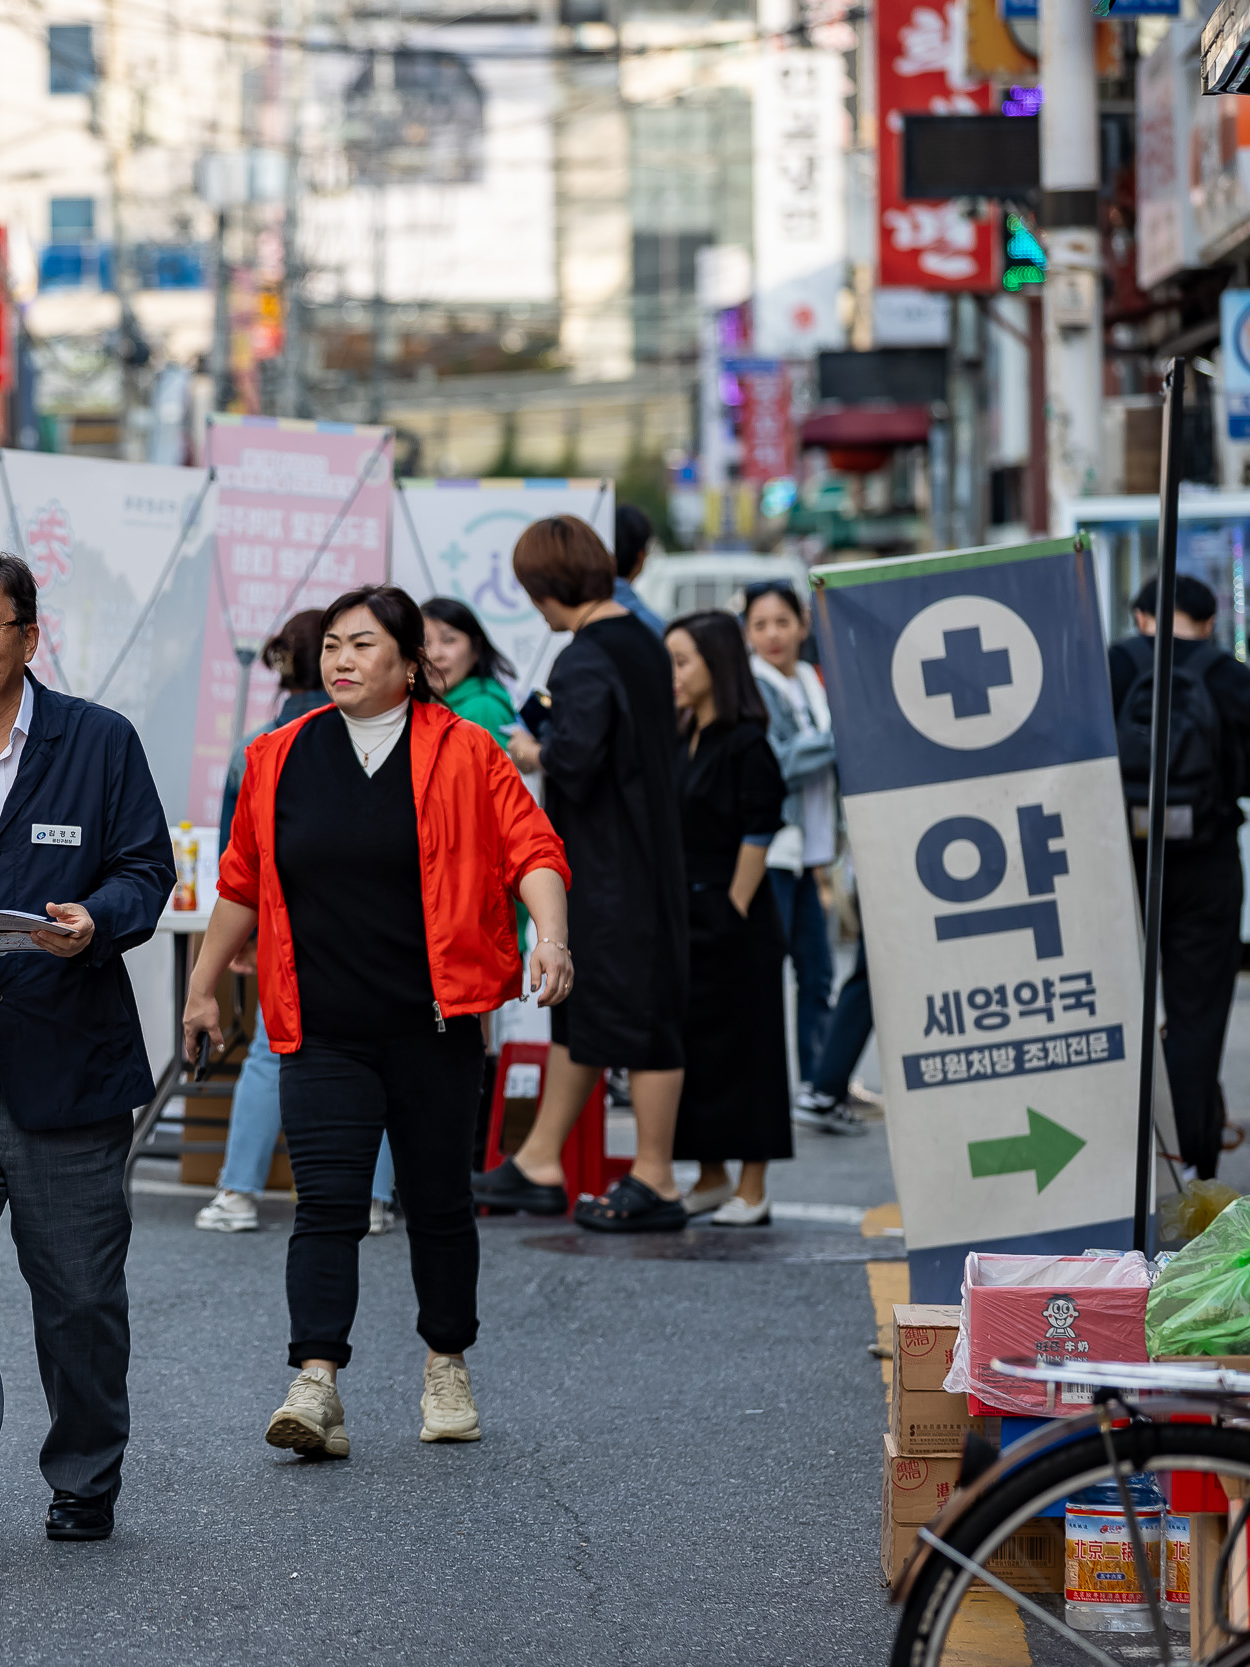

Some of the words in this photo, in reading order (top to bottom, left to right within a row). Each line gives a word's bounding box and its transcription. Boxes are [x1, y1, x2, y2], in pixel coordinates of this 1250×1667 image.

[915, 803, 1070, 961] 약
[923, 970, 1097, 1039] 세영약국
[919, 1045, 1016, 1084] 병원처방
[1022, 1032, 1110, 1070] 조제전문
